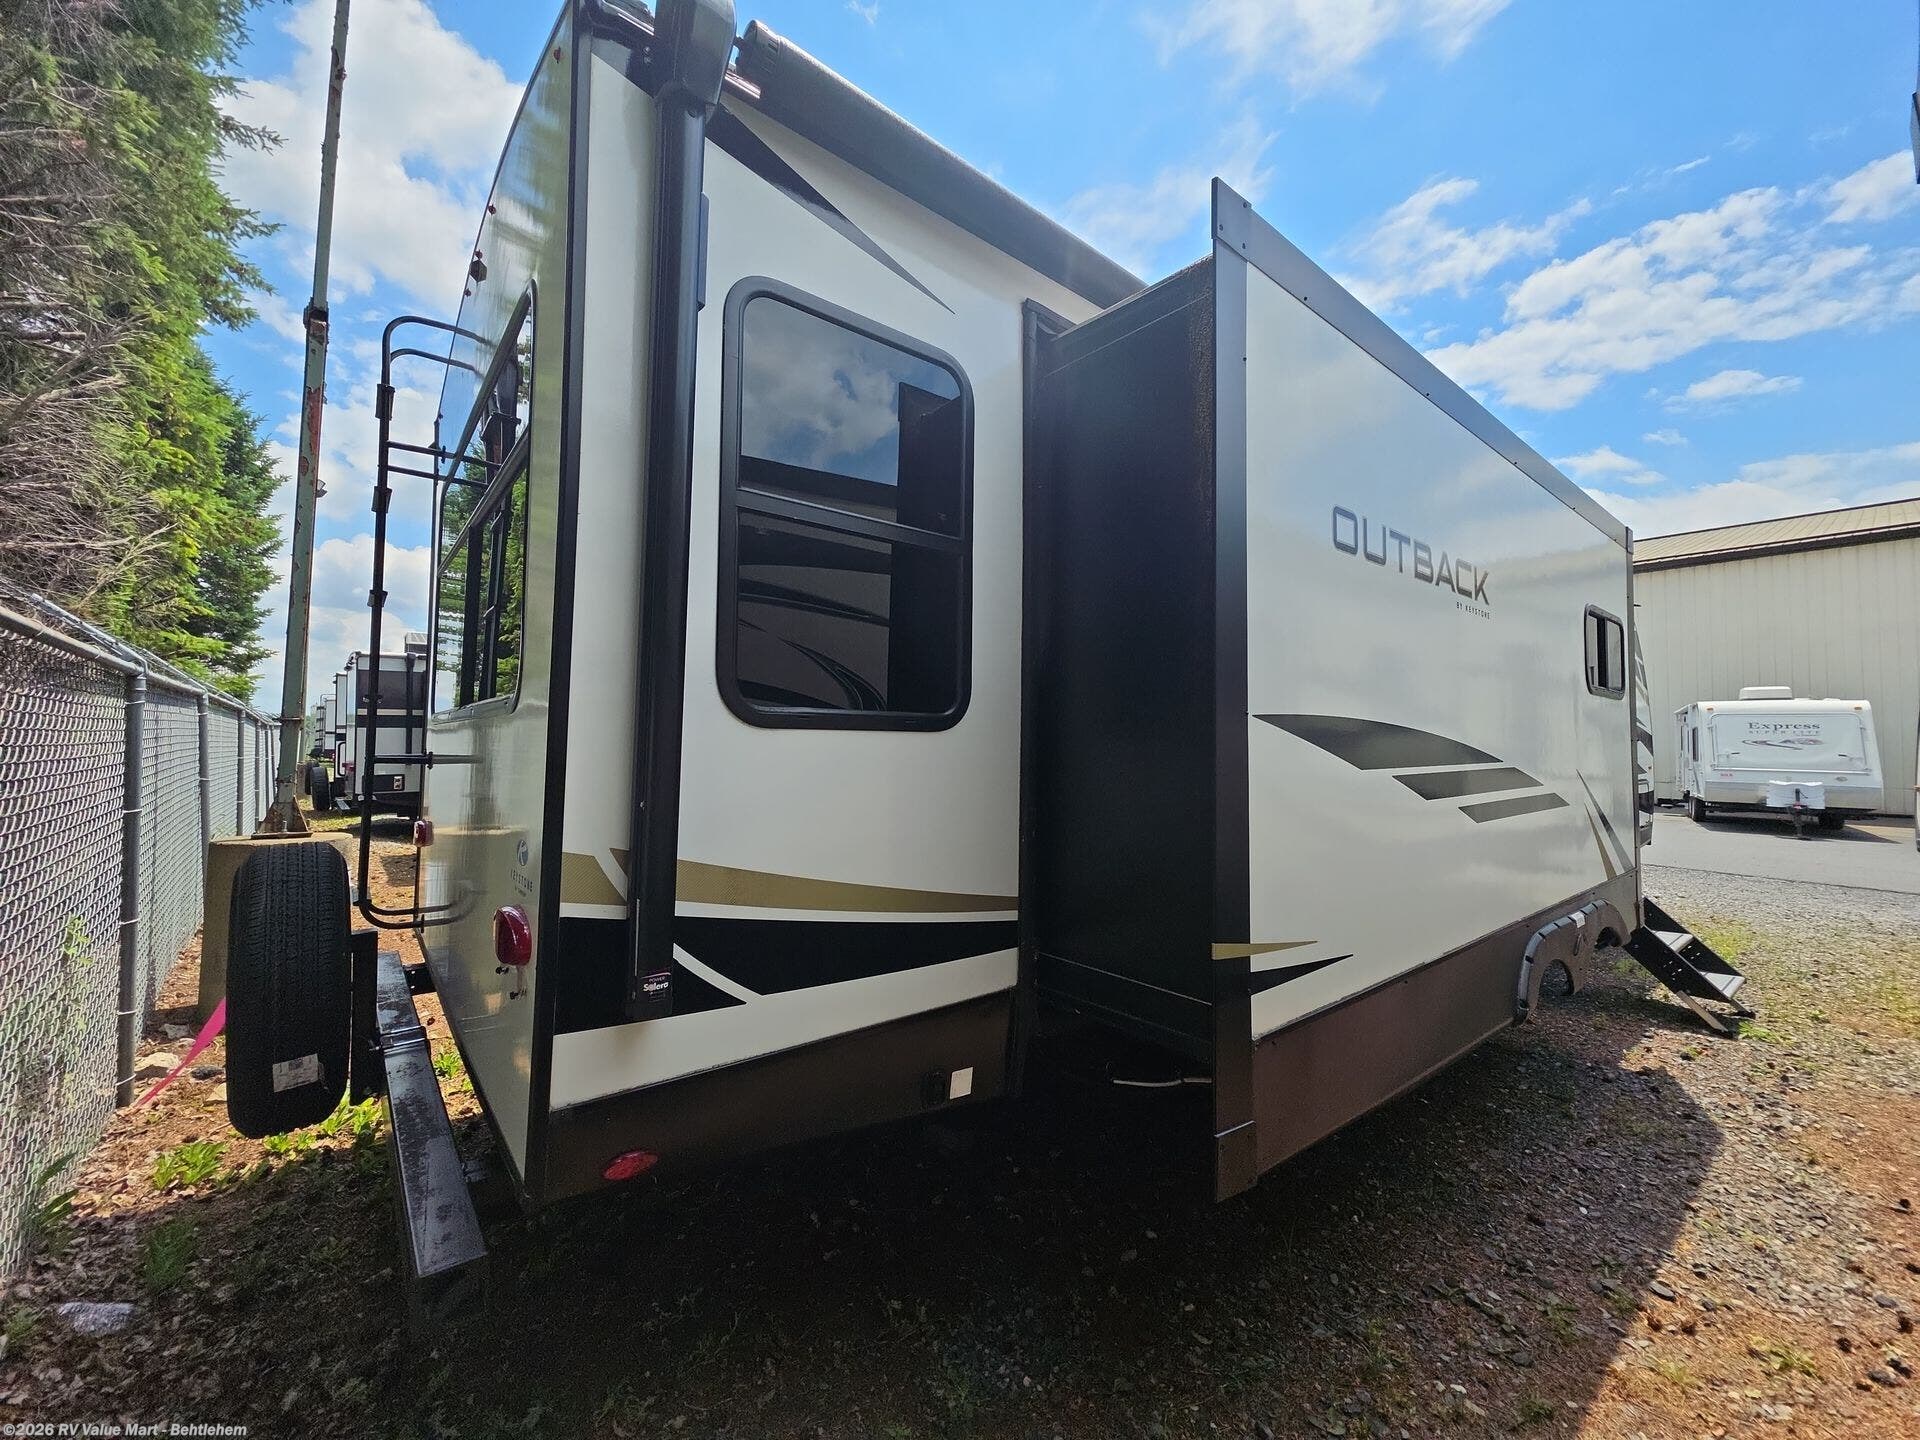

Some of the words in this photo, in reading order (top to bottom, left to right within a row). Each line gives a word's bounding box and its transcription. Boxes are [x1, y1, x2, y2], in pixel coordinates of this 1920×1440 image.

[1333, 506, 1489, 605] OUTBACK
[1456, 601, 1463, 610] BY
[1465, 605, 1490, 620] KEYSTONE
[1748, 722, 1821, 731] Express
